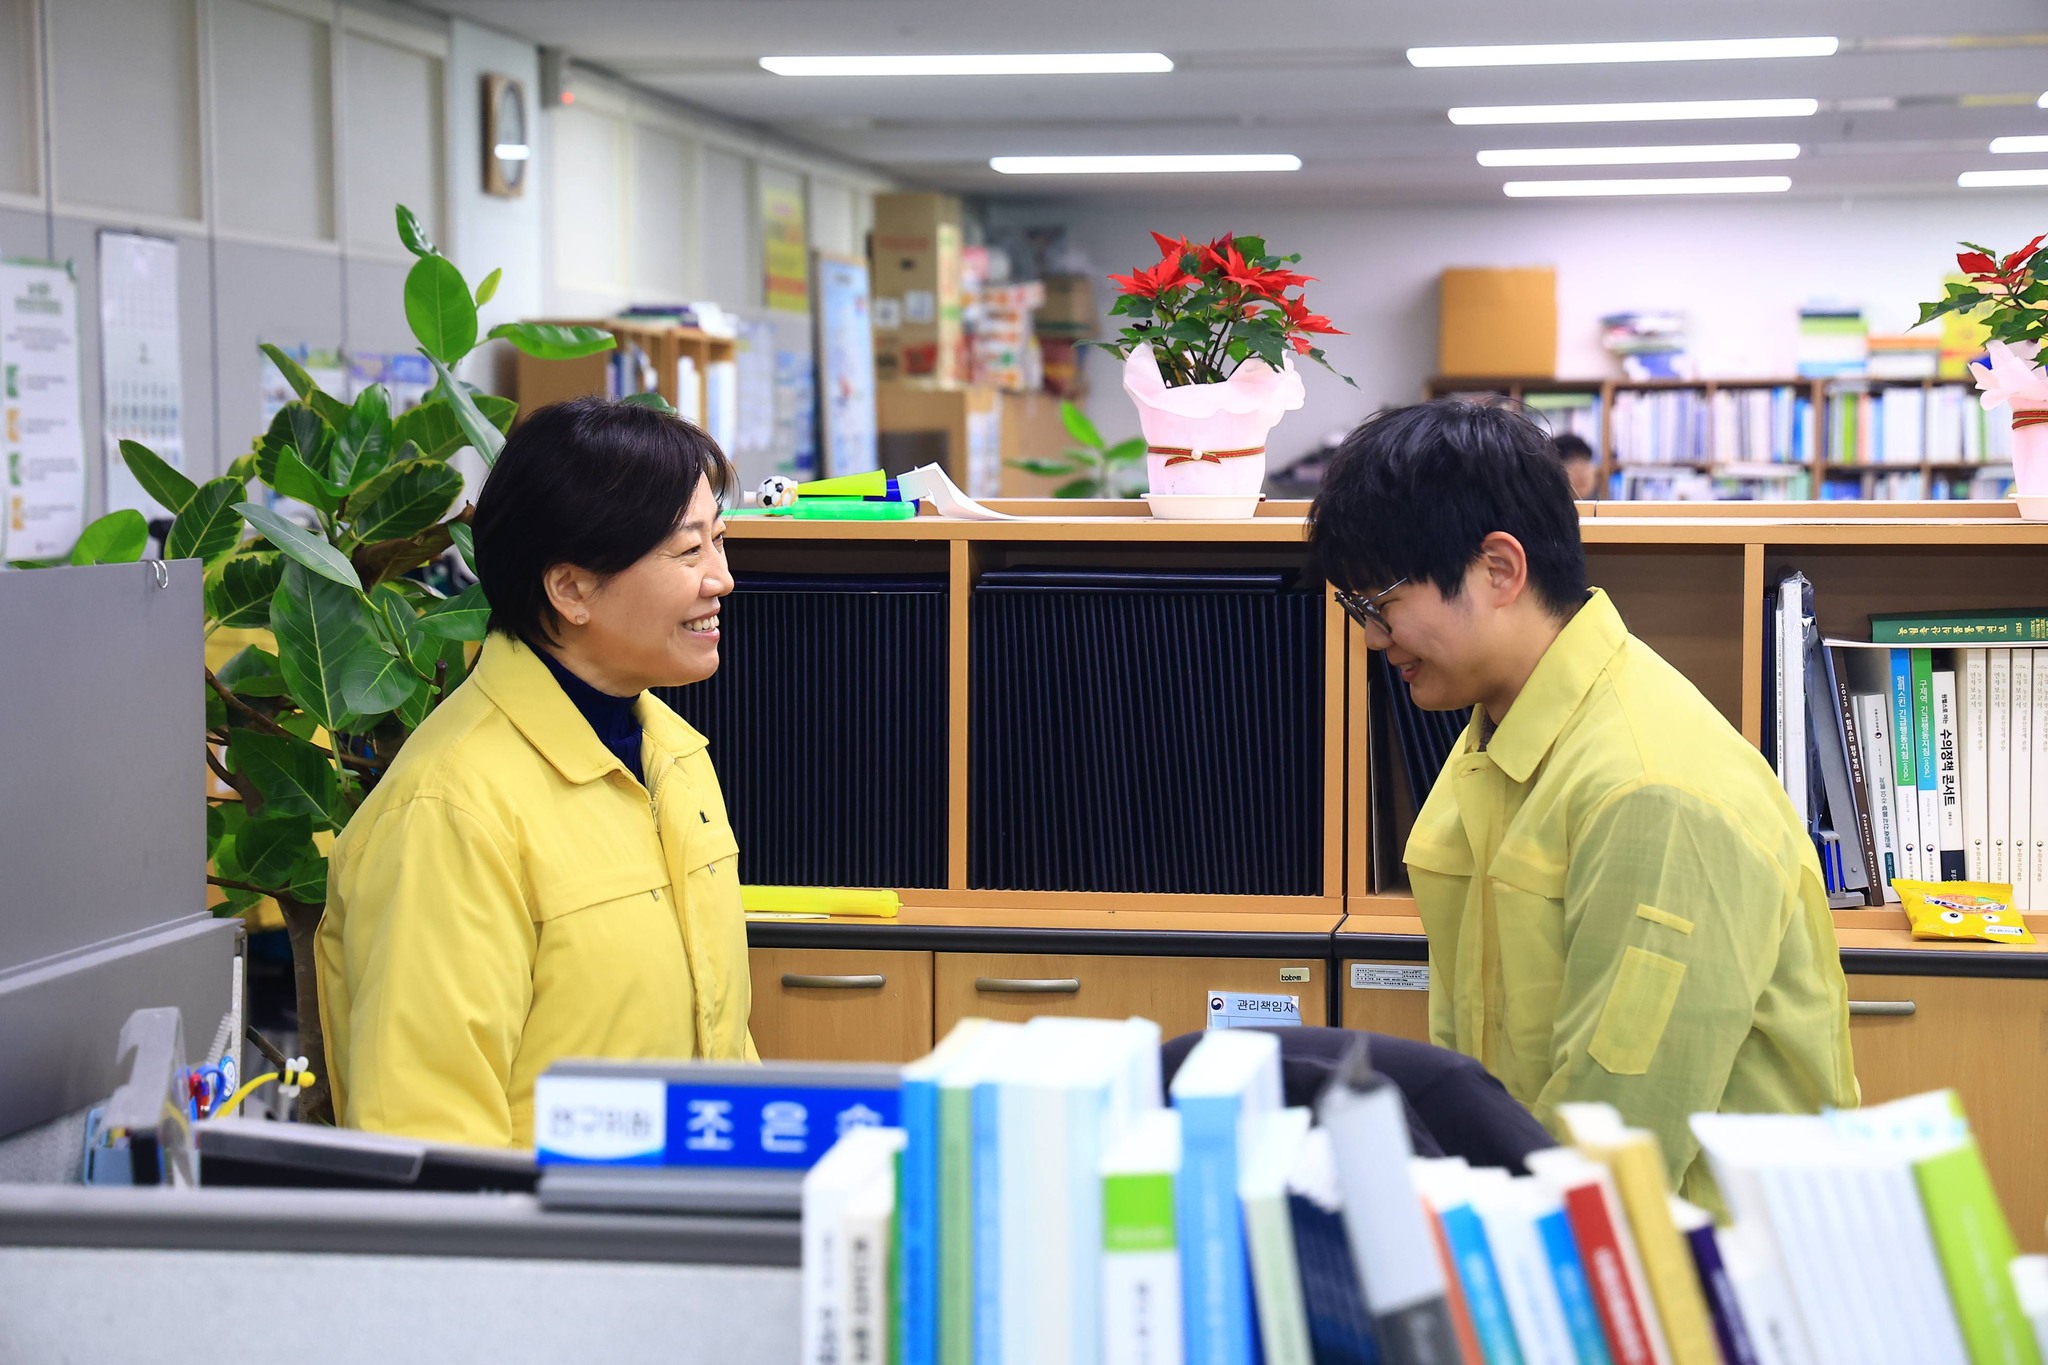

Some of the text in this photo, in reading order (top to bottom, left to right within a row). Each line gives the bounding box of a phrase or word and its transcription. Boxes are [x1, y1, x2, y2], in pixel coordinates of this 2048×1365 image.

[1840, 683, 1848, 708] 2023
[1897, 675, 1910, 782] 럼피스킨 긴급행동지침(SOP)
[1919, 680, 1931, 778] 구제역 긴급행동지침(SOP)
[1939, 729, 1955, 772] 수의정책
[1942, 774, 1956, 806] 콘서트
[1237, 999, 1295, 1014] 관리책임자
